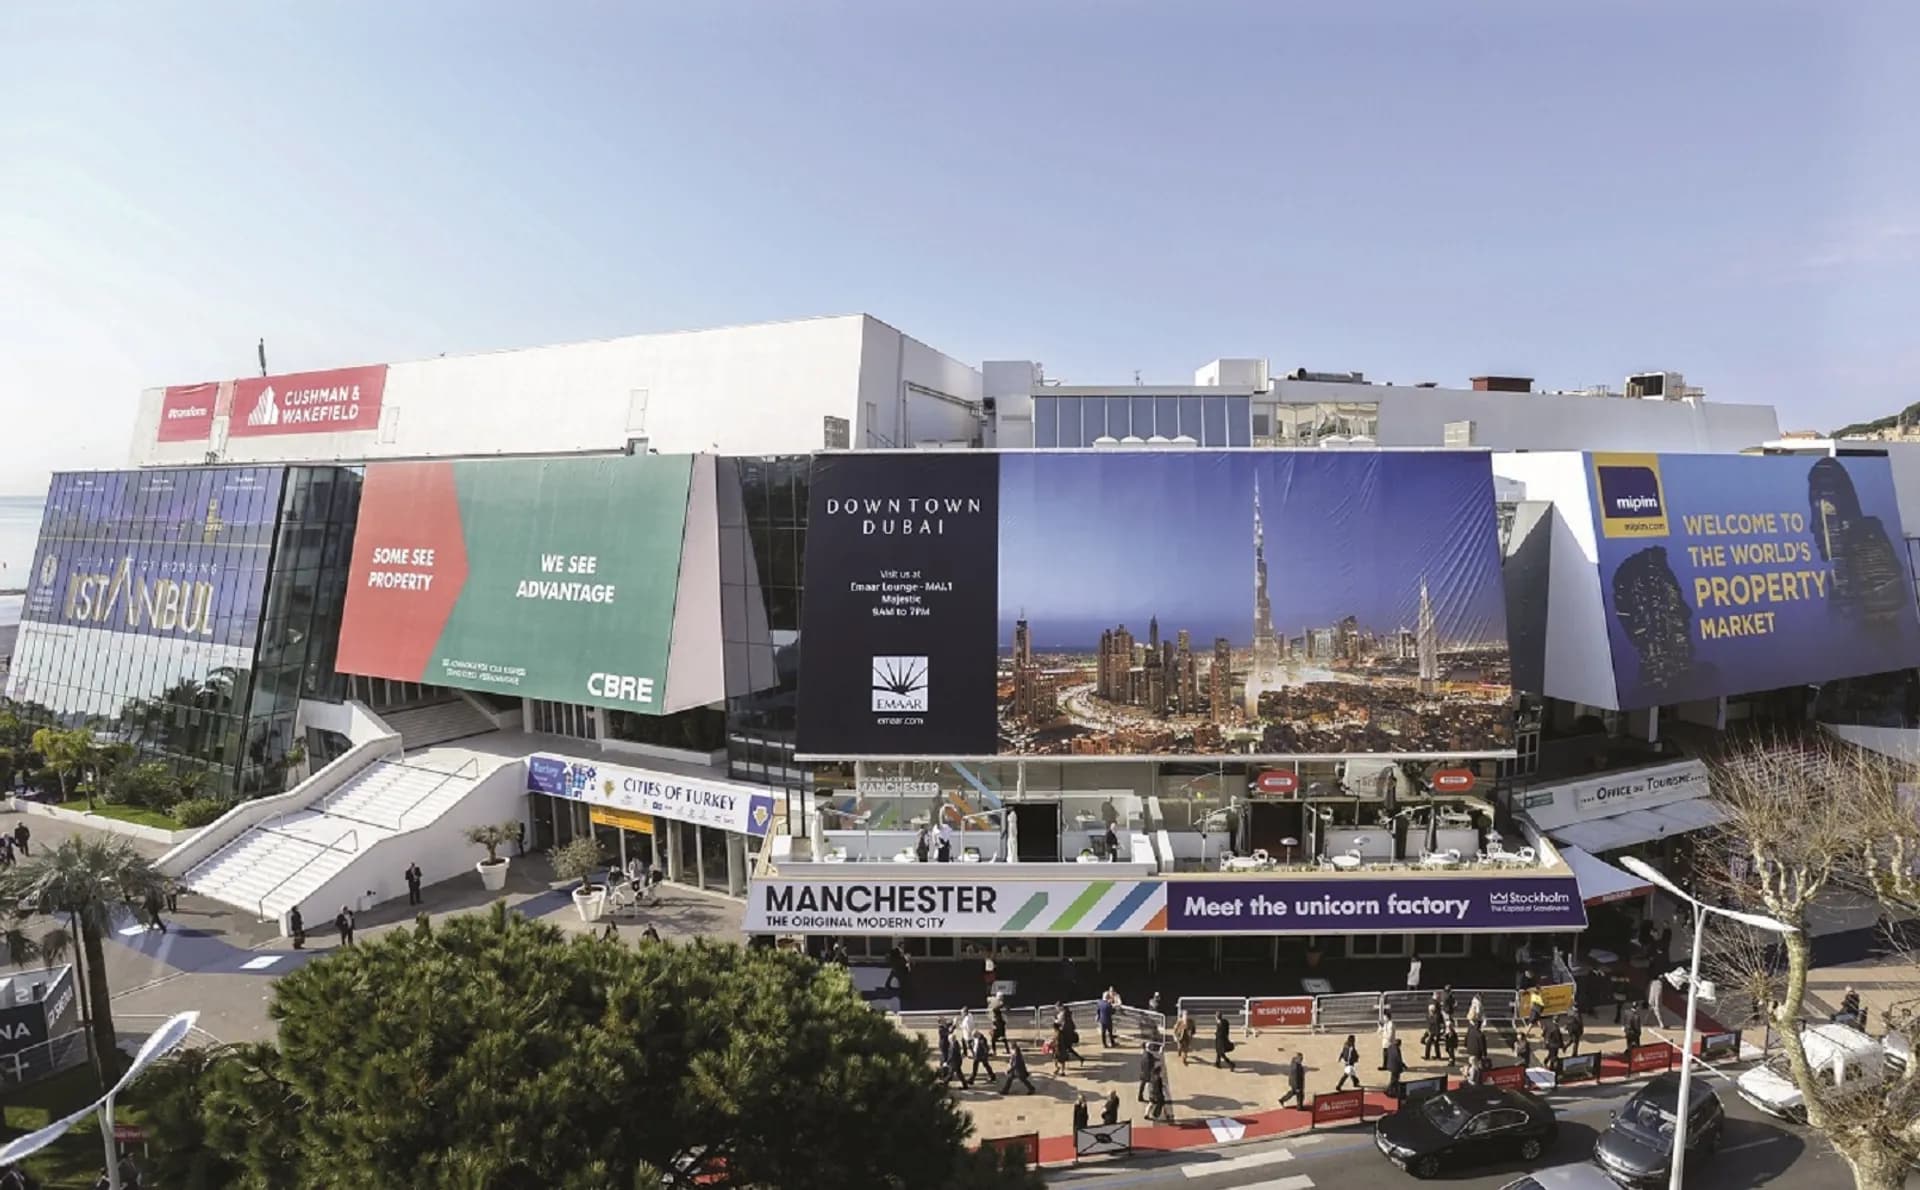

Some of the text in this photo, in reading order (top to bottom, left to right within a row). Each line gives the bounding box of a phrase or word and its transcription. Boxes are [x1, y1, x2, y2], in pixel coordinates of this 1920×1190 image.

[285, 385, 360, 406] CUSHMAN &
[282, 404, 359, 424] WAKEFIELD
[827, 498, 980, 514] DOWNTOWN
[1616, 494, 1658, 511] mipim
[862, 519, 943, 535] DUBAI
[1624, 522, 1665, 533] mipim.com
[1682, 512, 1804, 536] WELCOME TO
[372, 548, 435, 566] SOME SEE
[541, 553, 597, 574] WE SEE
[1687, 542, 1811, 567] THE WORLD'S
[368, 572, 433, 591] PROPERTY
[880, 569, 921, 579] Visit us at
[515, 580, 615, 603] ADVANTAGE
[850, 582, 881, 592] Emaar
[882, 582, 918, 593] Lounge
[1694, 569, 1827, 608] PROPERTY
[881, 595, 921, 606] Majestic
[872, 607, 930, 616] 9AM to 7PM
[1700, 612, 1776, 639] MARKET
[587, 672, 654, 703] CBRE
[877, 699, 922, 709] EMAAR
[623, 777, 662, 797] CITIES
[665, 785, 683, 800] OF
[685, 789, 737, 811] TURKEY
[857, 782, 939, 793] MANCHESTER
[765, 885, 998, 913] MANCHESTER
[1184, 893, 1470, 919] Meet the unicorn factory
[1509, 892, 1569, 904] Stockholm
[766, 914, 945, 929] THE ORIGINAL MODERN CITY
